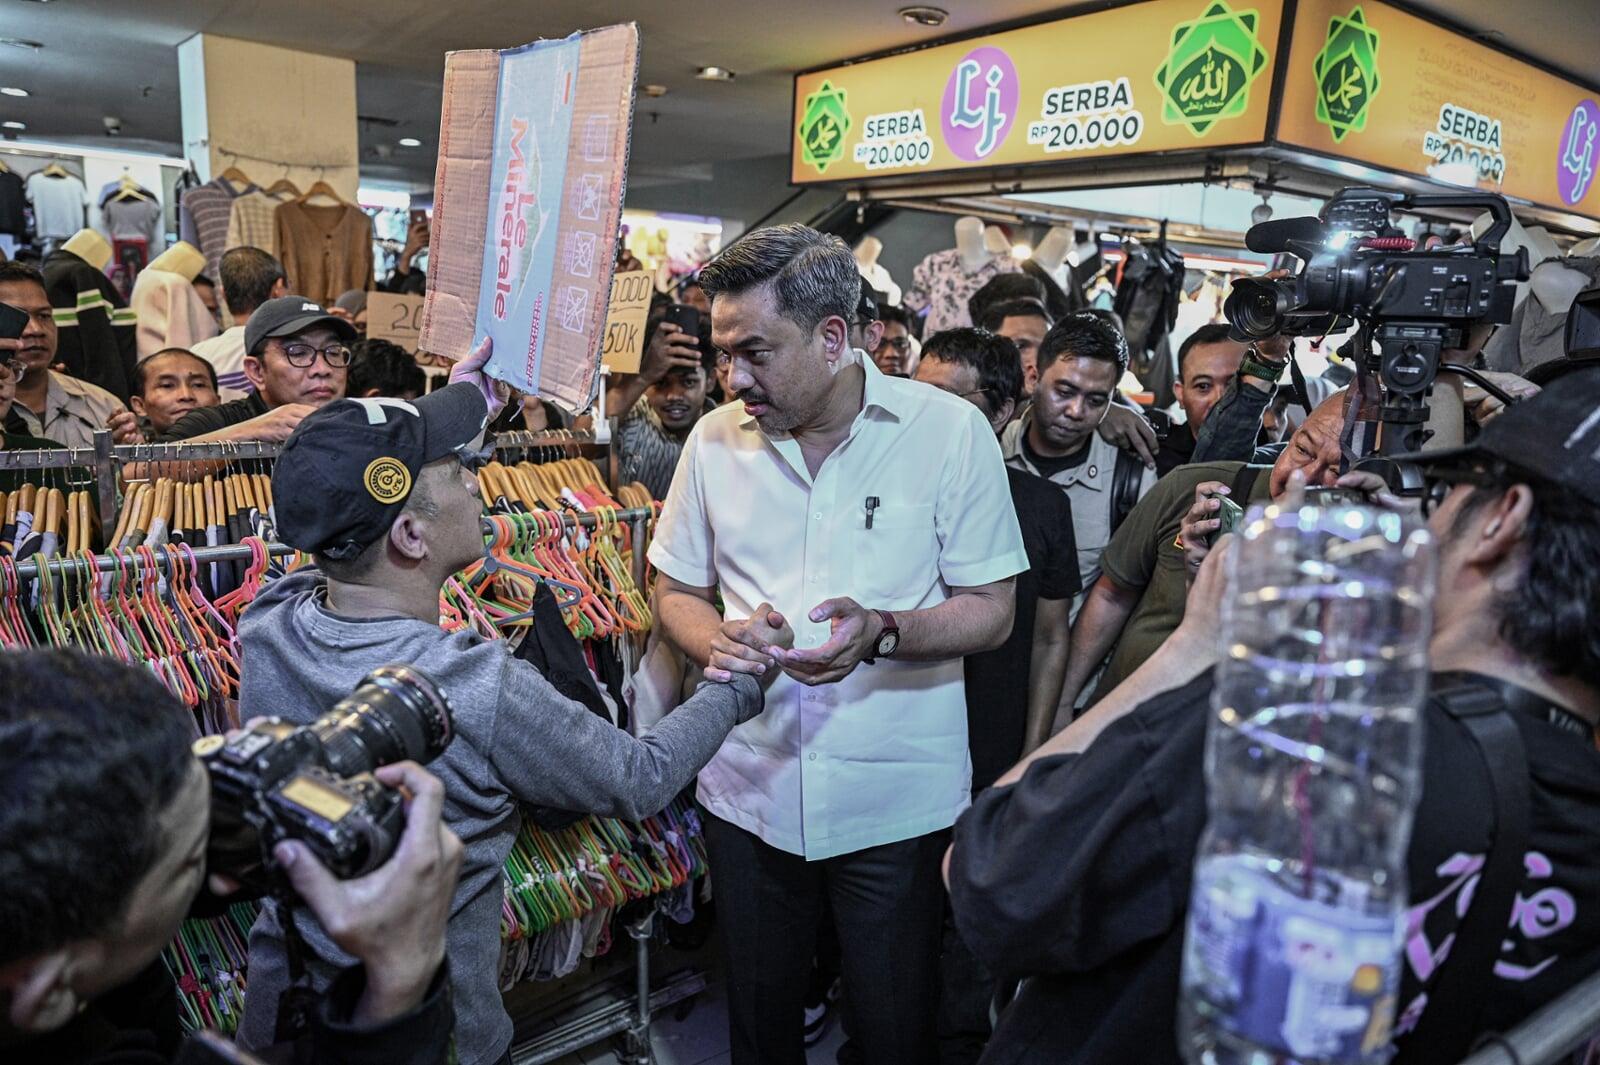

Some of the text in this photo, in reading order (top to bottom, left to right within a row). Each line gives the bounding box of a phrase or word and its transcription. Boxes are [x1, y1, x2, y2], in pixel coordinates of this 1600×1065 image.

[1046, 83, 1129, 115] SERBA
[866, 114, 922, 138] SERBA
[1440, 108, 1500, 147] SERBA
[494, 115, 528, 319] Minerale
[514, 193, 535, 248] Le
